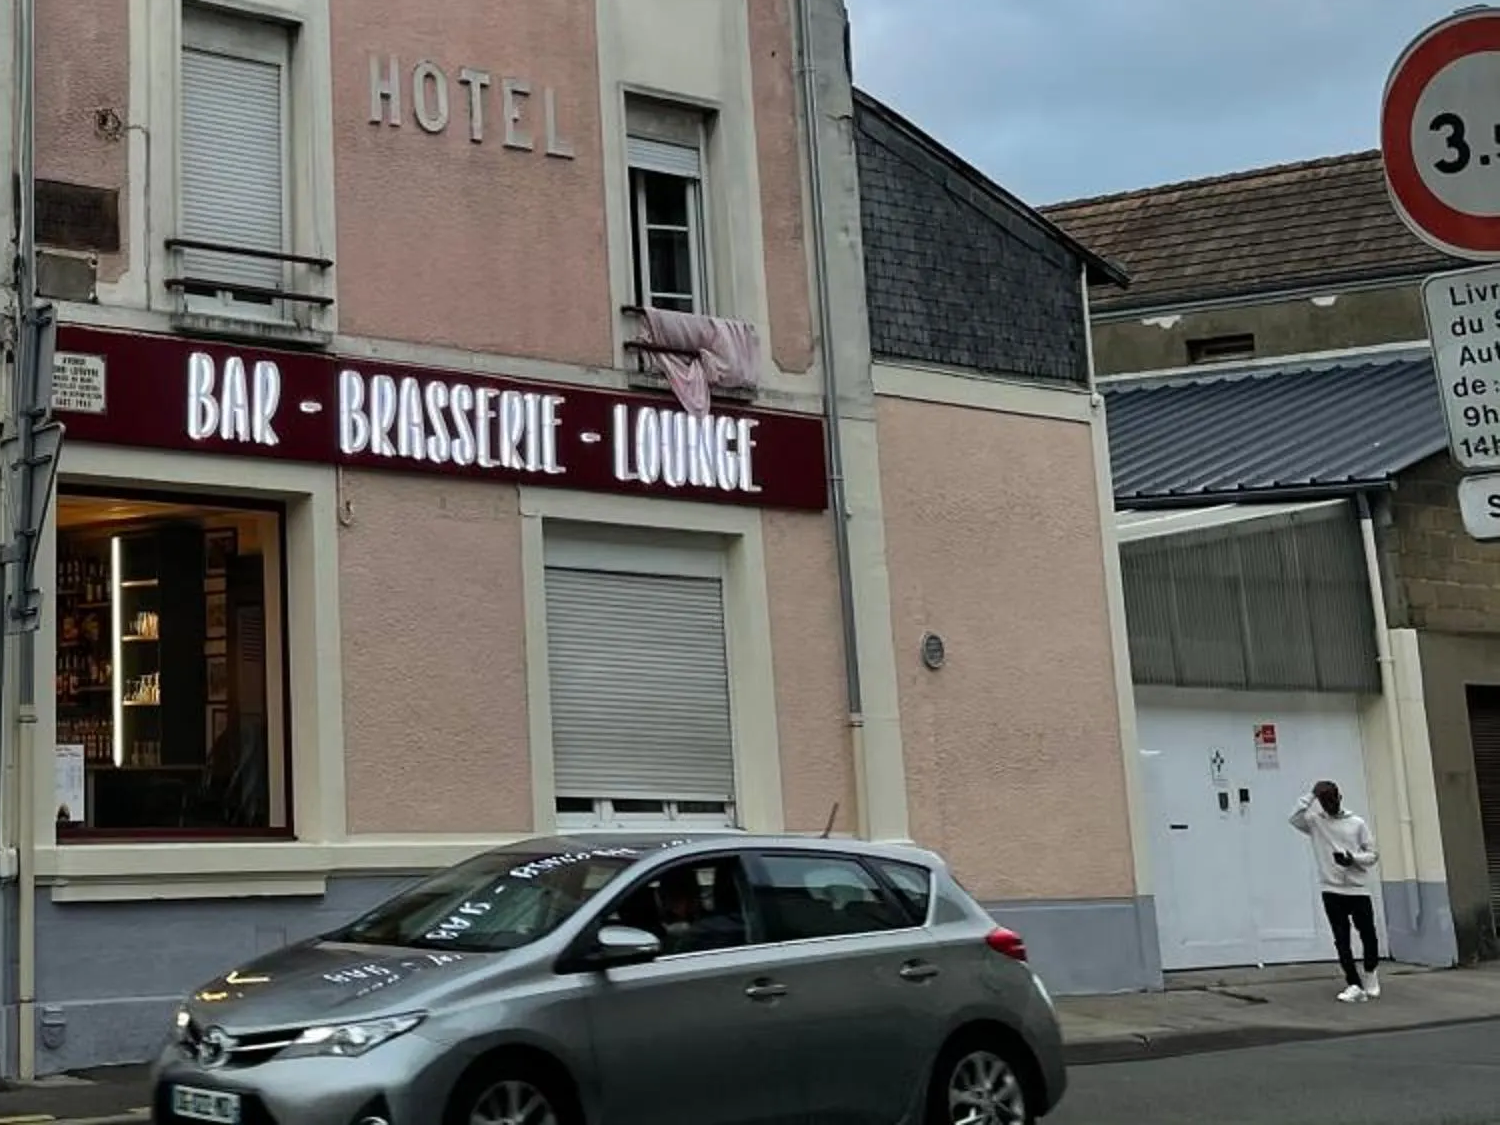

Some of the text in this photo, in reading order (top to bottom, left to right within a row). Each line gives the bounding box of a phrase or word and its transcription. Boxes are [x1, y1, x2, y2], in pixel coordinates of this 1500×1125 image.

[369, 52, 575, 160] HOTEL
[1429, 112, 1500, 174] 3.
[1451, 315, 1485, 337] du
[186, 351, 281, 446] BAR
[338, 369, 567, 474] BRASSERIE
[613, 403, 763, 493] LOUNGE
